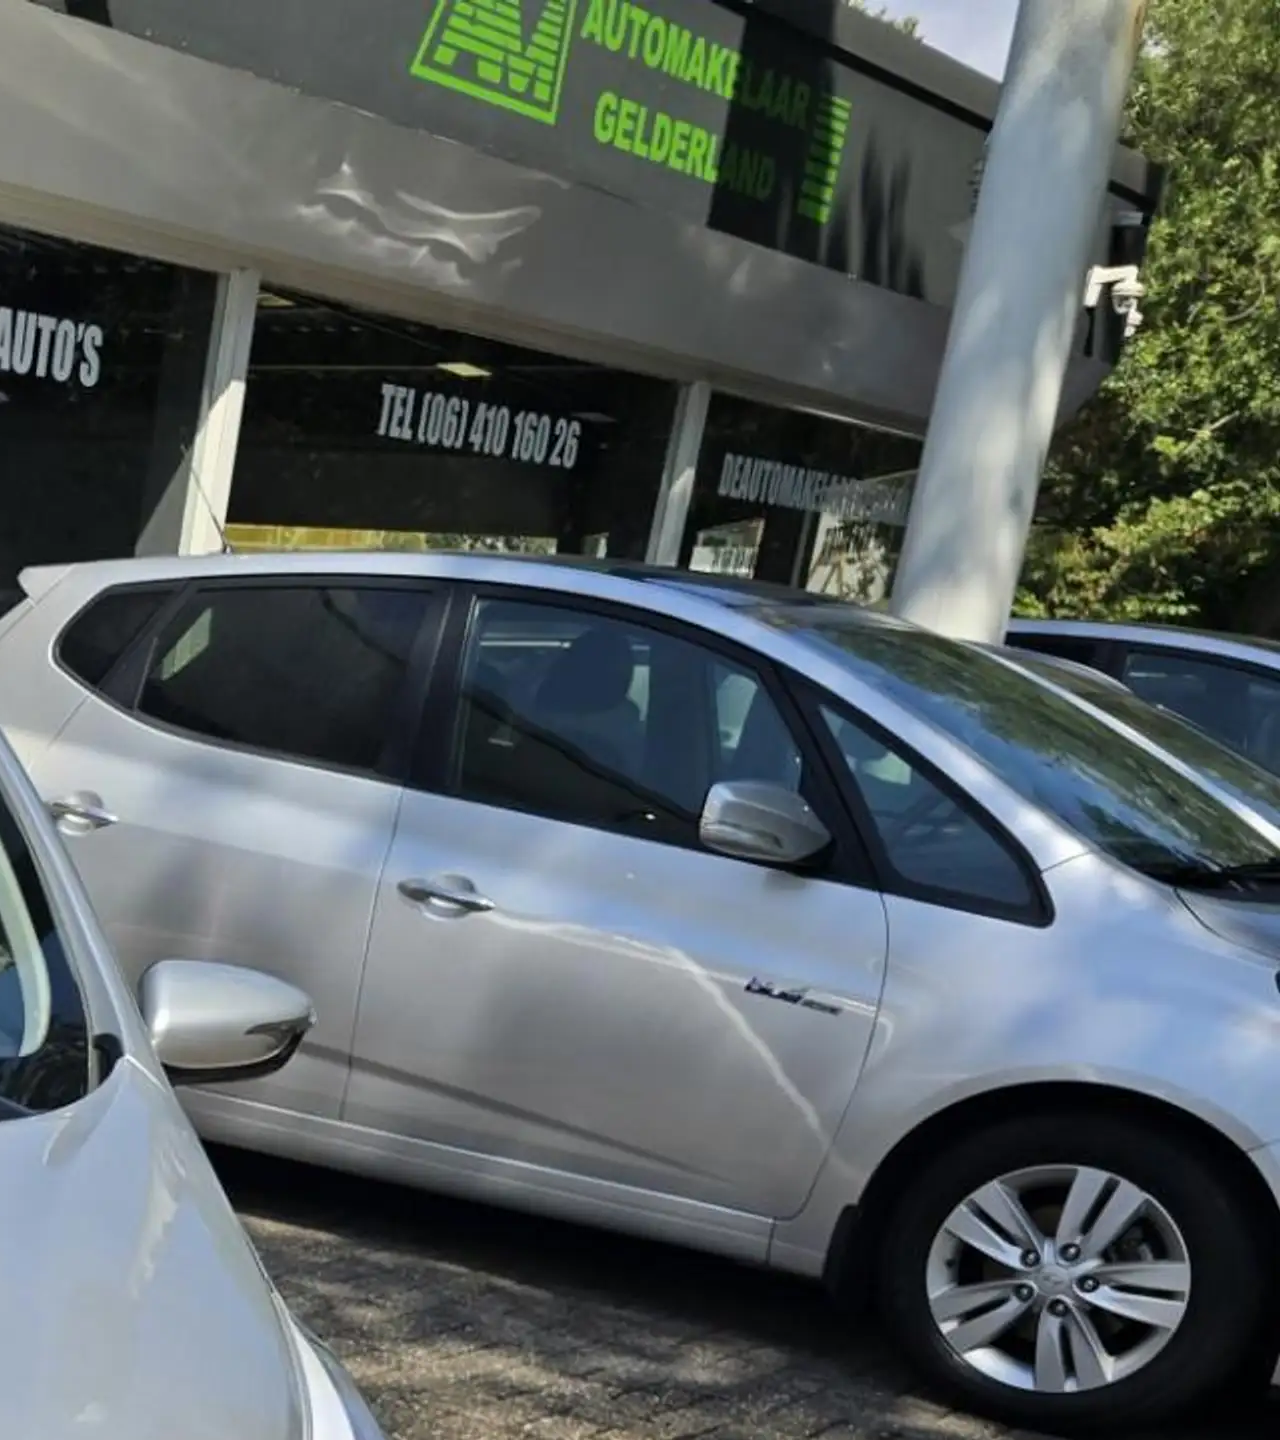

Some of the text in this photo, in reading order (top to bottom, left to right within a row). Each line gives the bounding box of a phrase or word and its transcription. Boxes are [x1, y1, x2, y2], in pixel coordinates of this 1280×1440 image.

[580, 0, 810, 130] AUTOMAKELAAR
[593, 91, 776, 200] GELDERLAND
[376, 382, 581, 469] TEL (06) 410 160 26
